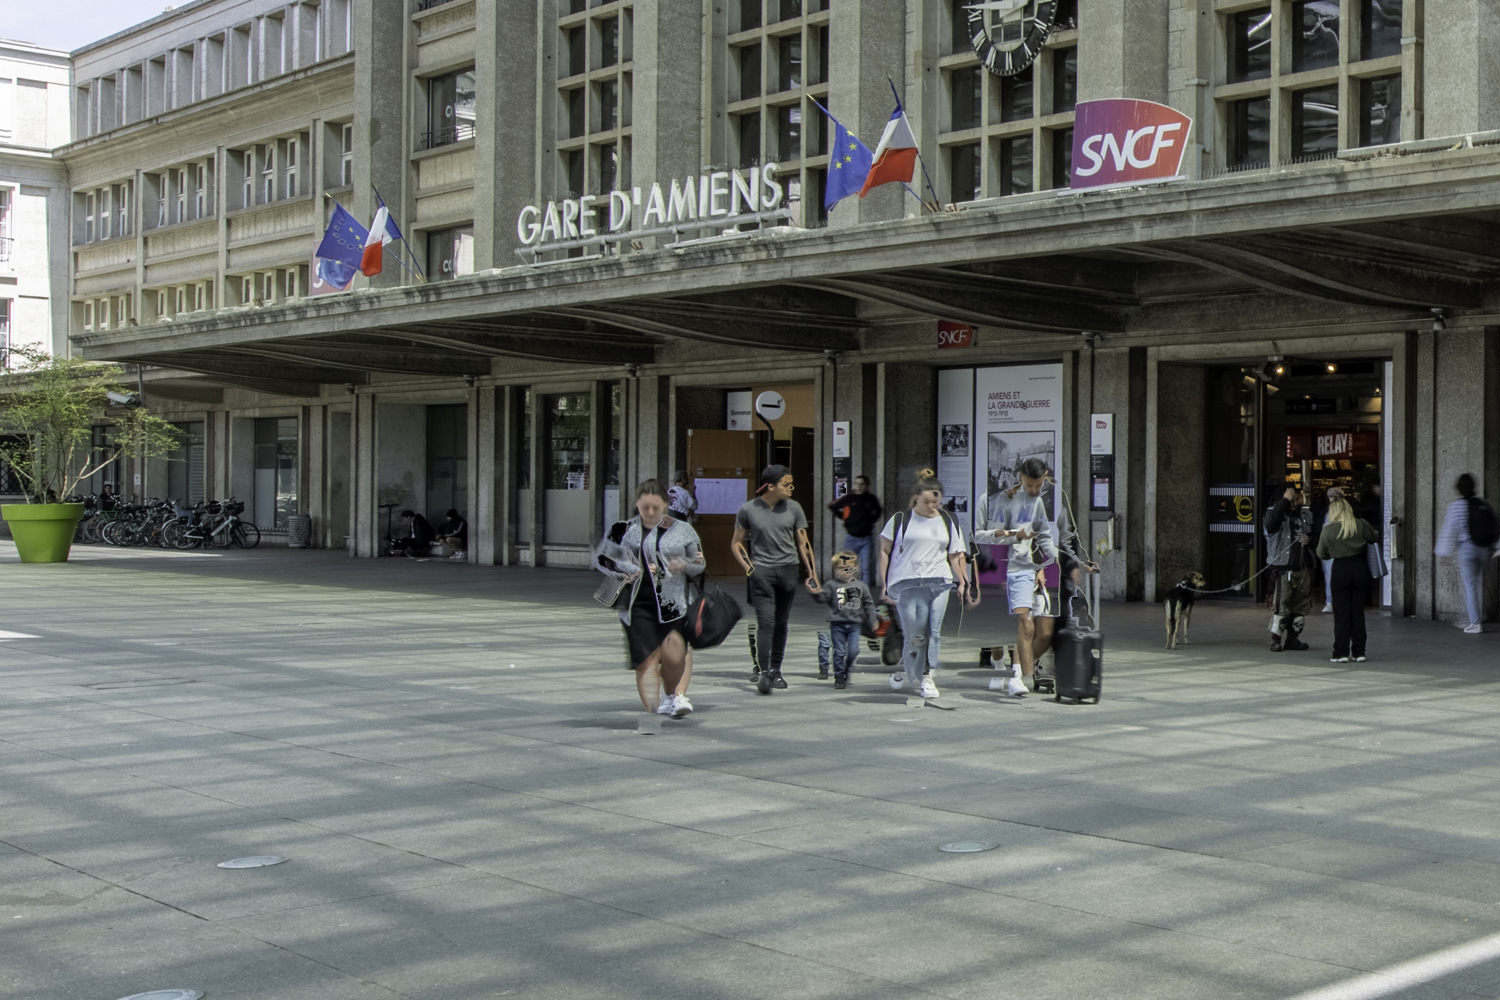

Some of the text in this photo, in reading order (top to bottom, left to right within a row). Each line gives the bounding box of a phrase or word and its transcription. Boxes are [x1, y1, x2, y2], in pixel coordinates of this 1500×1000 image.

[1075, 122, 1182, 177] SNCF
[517, 162, 783, 245] GARE D'AMIENS
[939, 329, 969, 345] SNCF
[988, 391, 1021, 400] AMIENS ET
[988, 402, 996, 410] LA
[1026, 400, 1050, 409] GUERRE
[1317, 433, 1348, 456] RELAY
